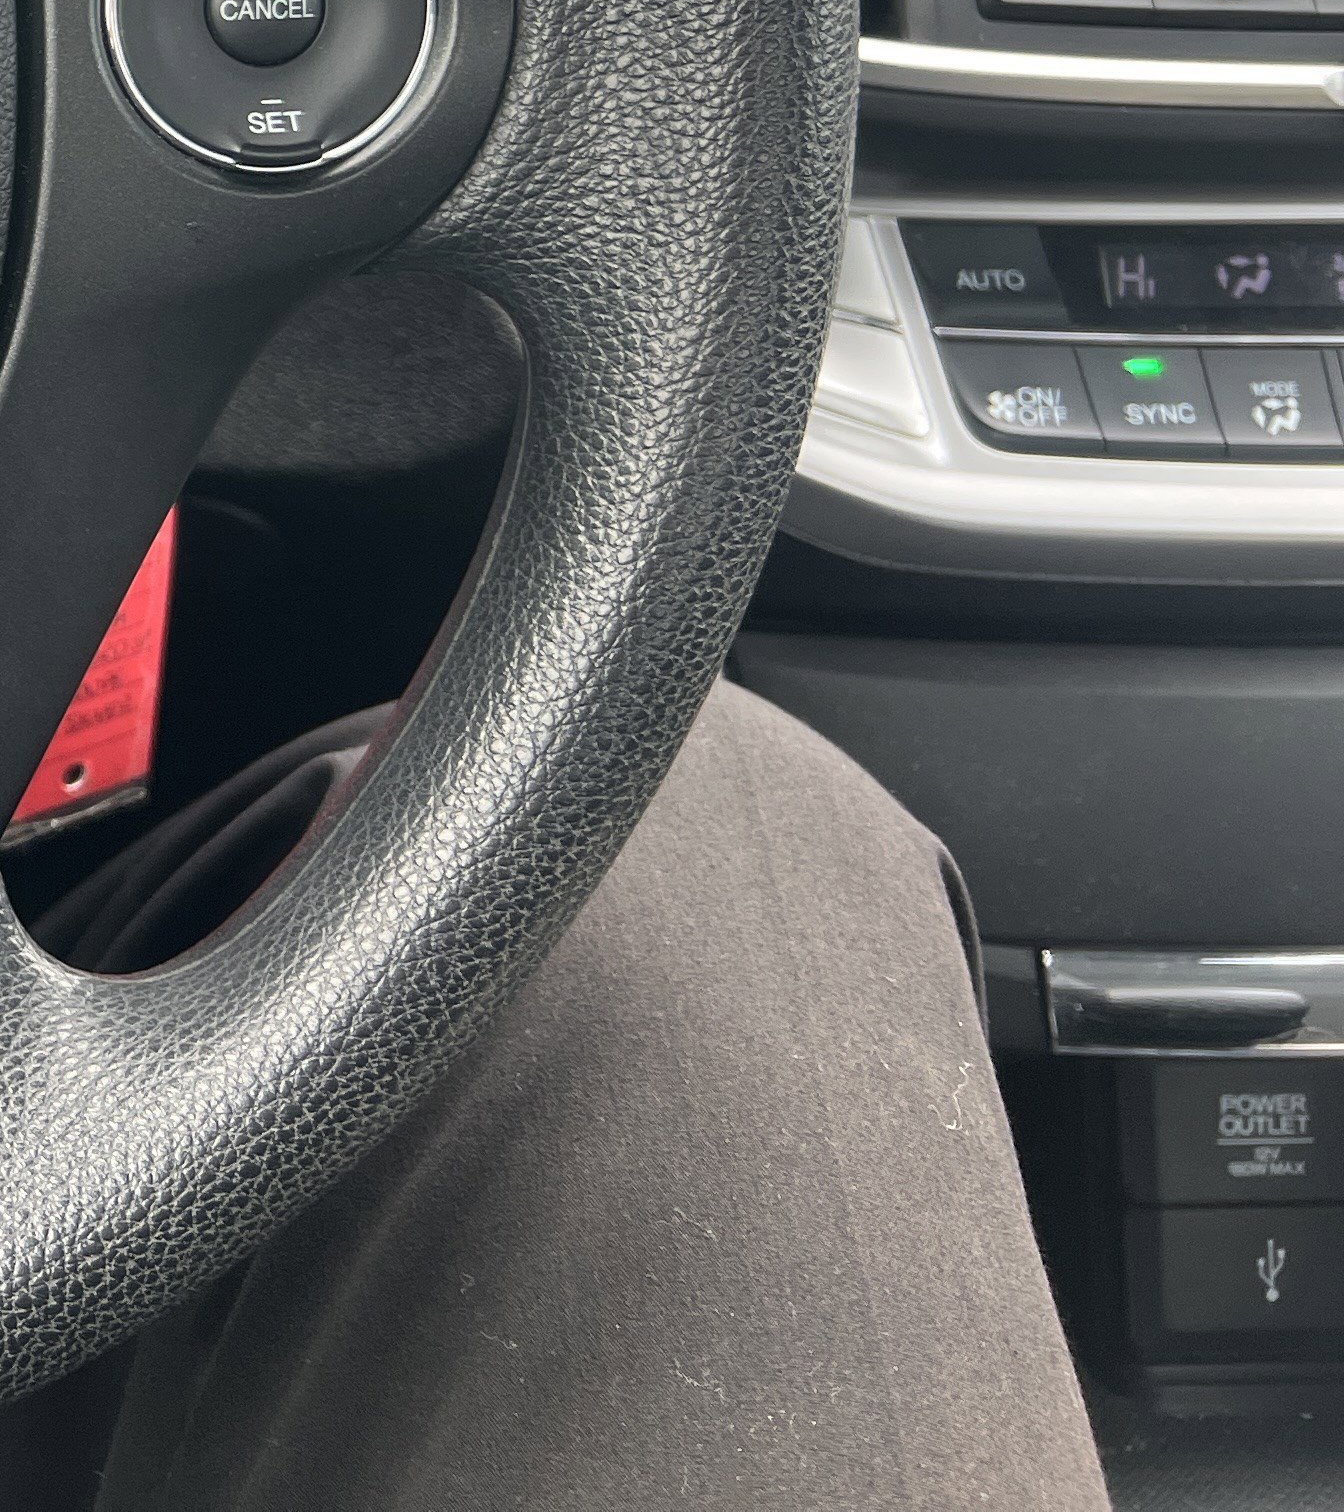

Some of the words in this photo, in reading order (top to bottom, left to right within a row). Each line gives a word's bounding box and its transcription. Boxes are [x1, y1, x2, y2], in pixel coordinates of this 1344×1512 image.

[247, 110, 305, 134] SET
[957, 269, 1026, 291] AUTO
[1250, 381, 1301, 397] MODE
[1018, 405, 1068, 427] OFF
[1124, 402, 1197, 426] SYNC
[1219, 1094, 1308, 1116] POWER
[1218, 1114, 1311, 1137] OUTLET
